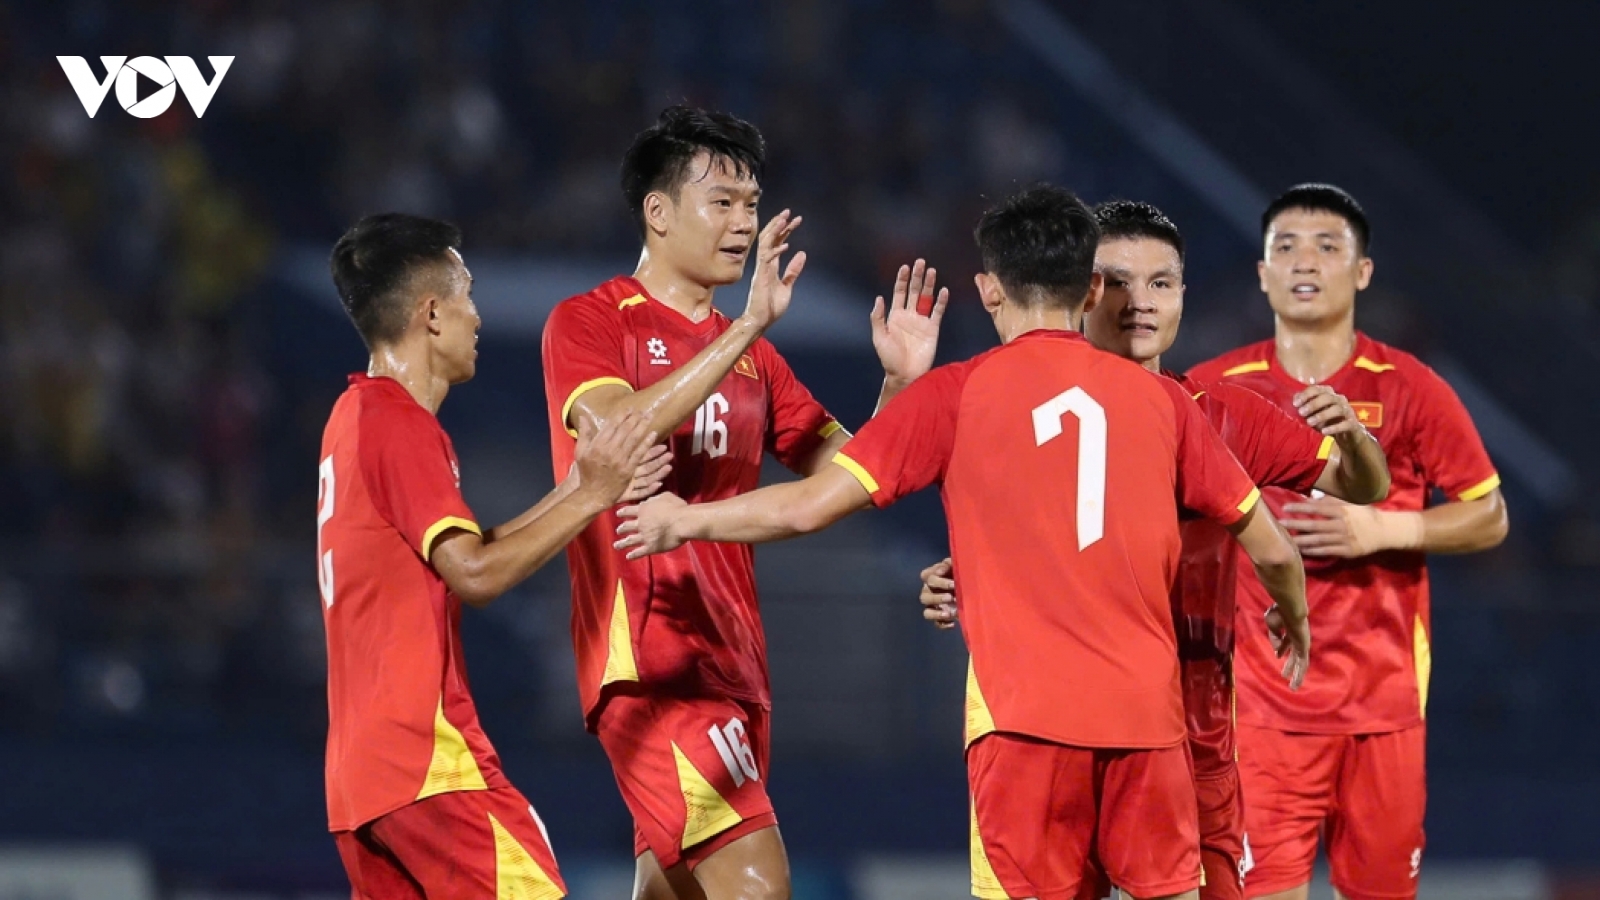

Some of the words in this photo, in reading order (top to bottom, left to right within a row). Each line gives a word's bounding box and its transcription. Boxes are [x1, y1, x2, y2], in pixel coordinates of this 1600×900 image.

[692, 392, 730, 459] 16
[1031, 386, 1107, 551] 7
[707, 717, 759, 788] 16
